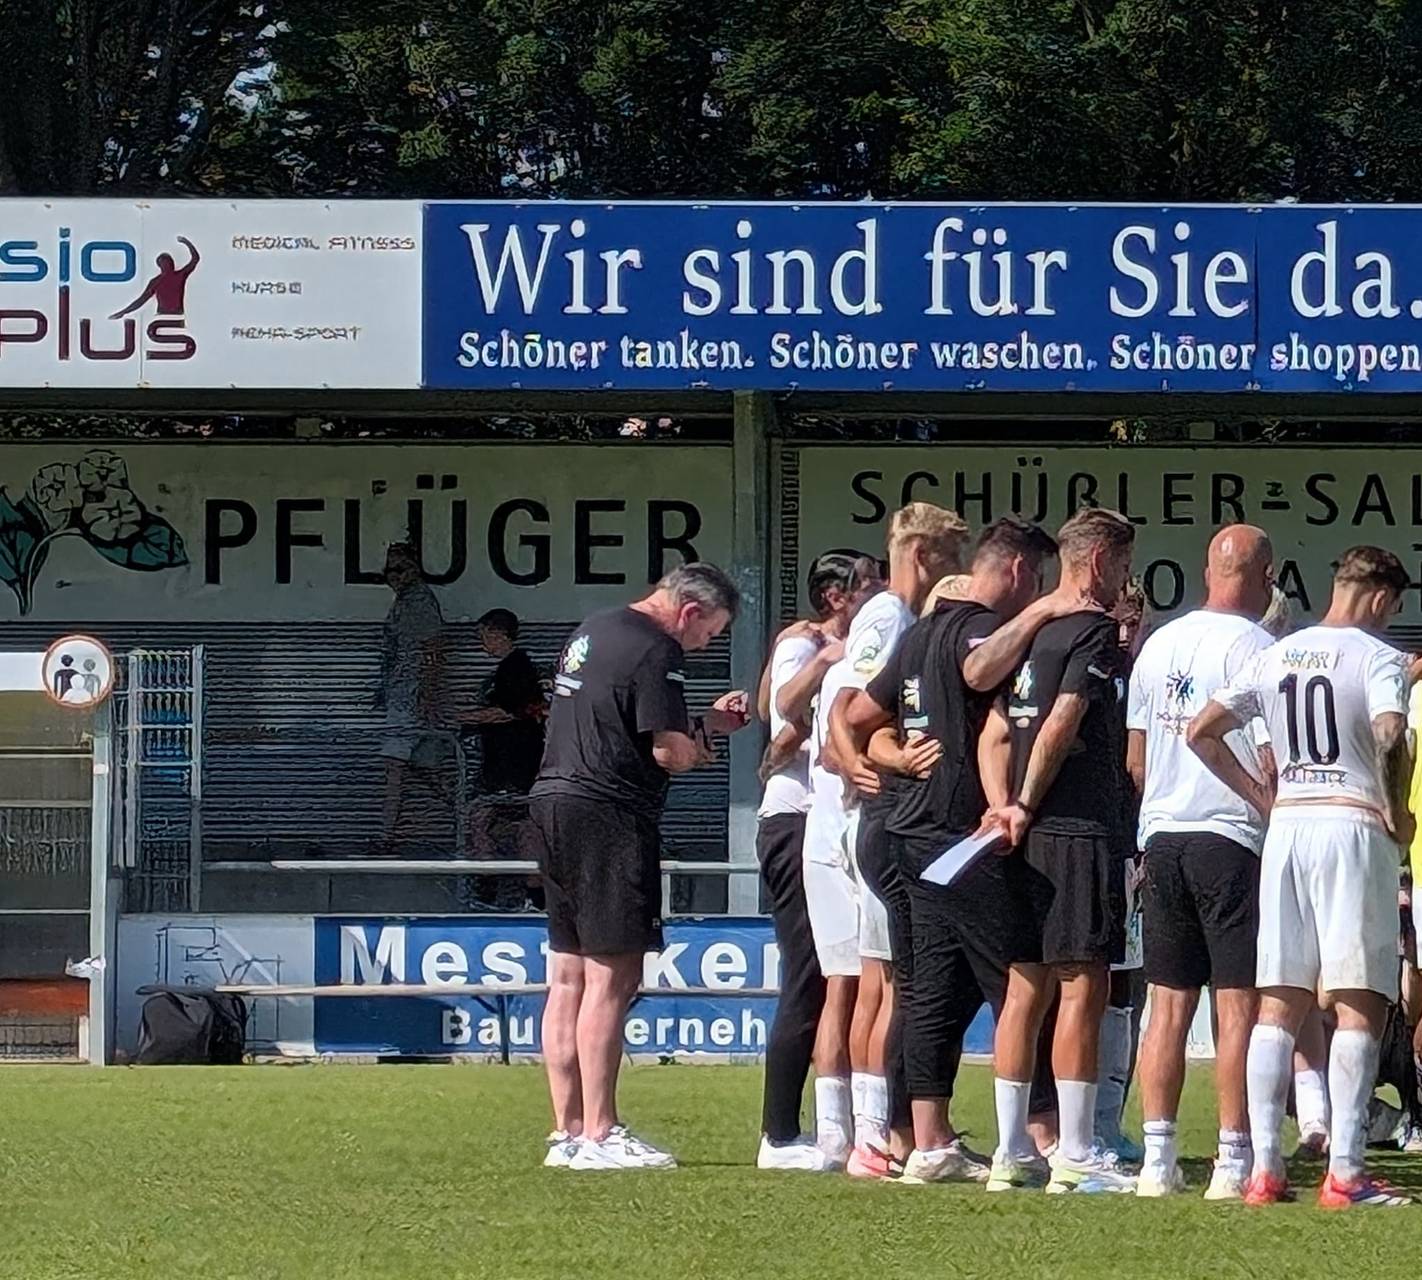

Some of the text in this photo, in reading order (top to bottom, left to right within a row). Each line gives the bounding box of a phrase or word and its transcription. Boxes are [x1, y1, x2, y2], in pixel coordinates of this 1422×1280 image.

[459, 219, 643, 315] Wir
[682, 218, 883, 316] sind
[922, 217, 1067, 317] für
[1108, 221, 1249, 318] Sie
[456, 331, 606, 370] Schöner
[620, 328, 755, 369] tanken.
[769, 333, 918, 369] Schöner
[932, 331, 1098, 371] waschen.
[1110, 331, 1256, 371] Schöner
[204, 473, 702, 586] PFLÜGER
[1278, 672, 1341, 766] 10
